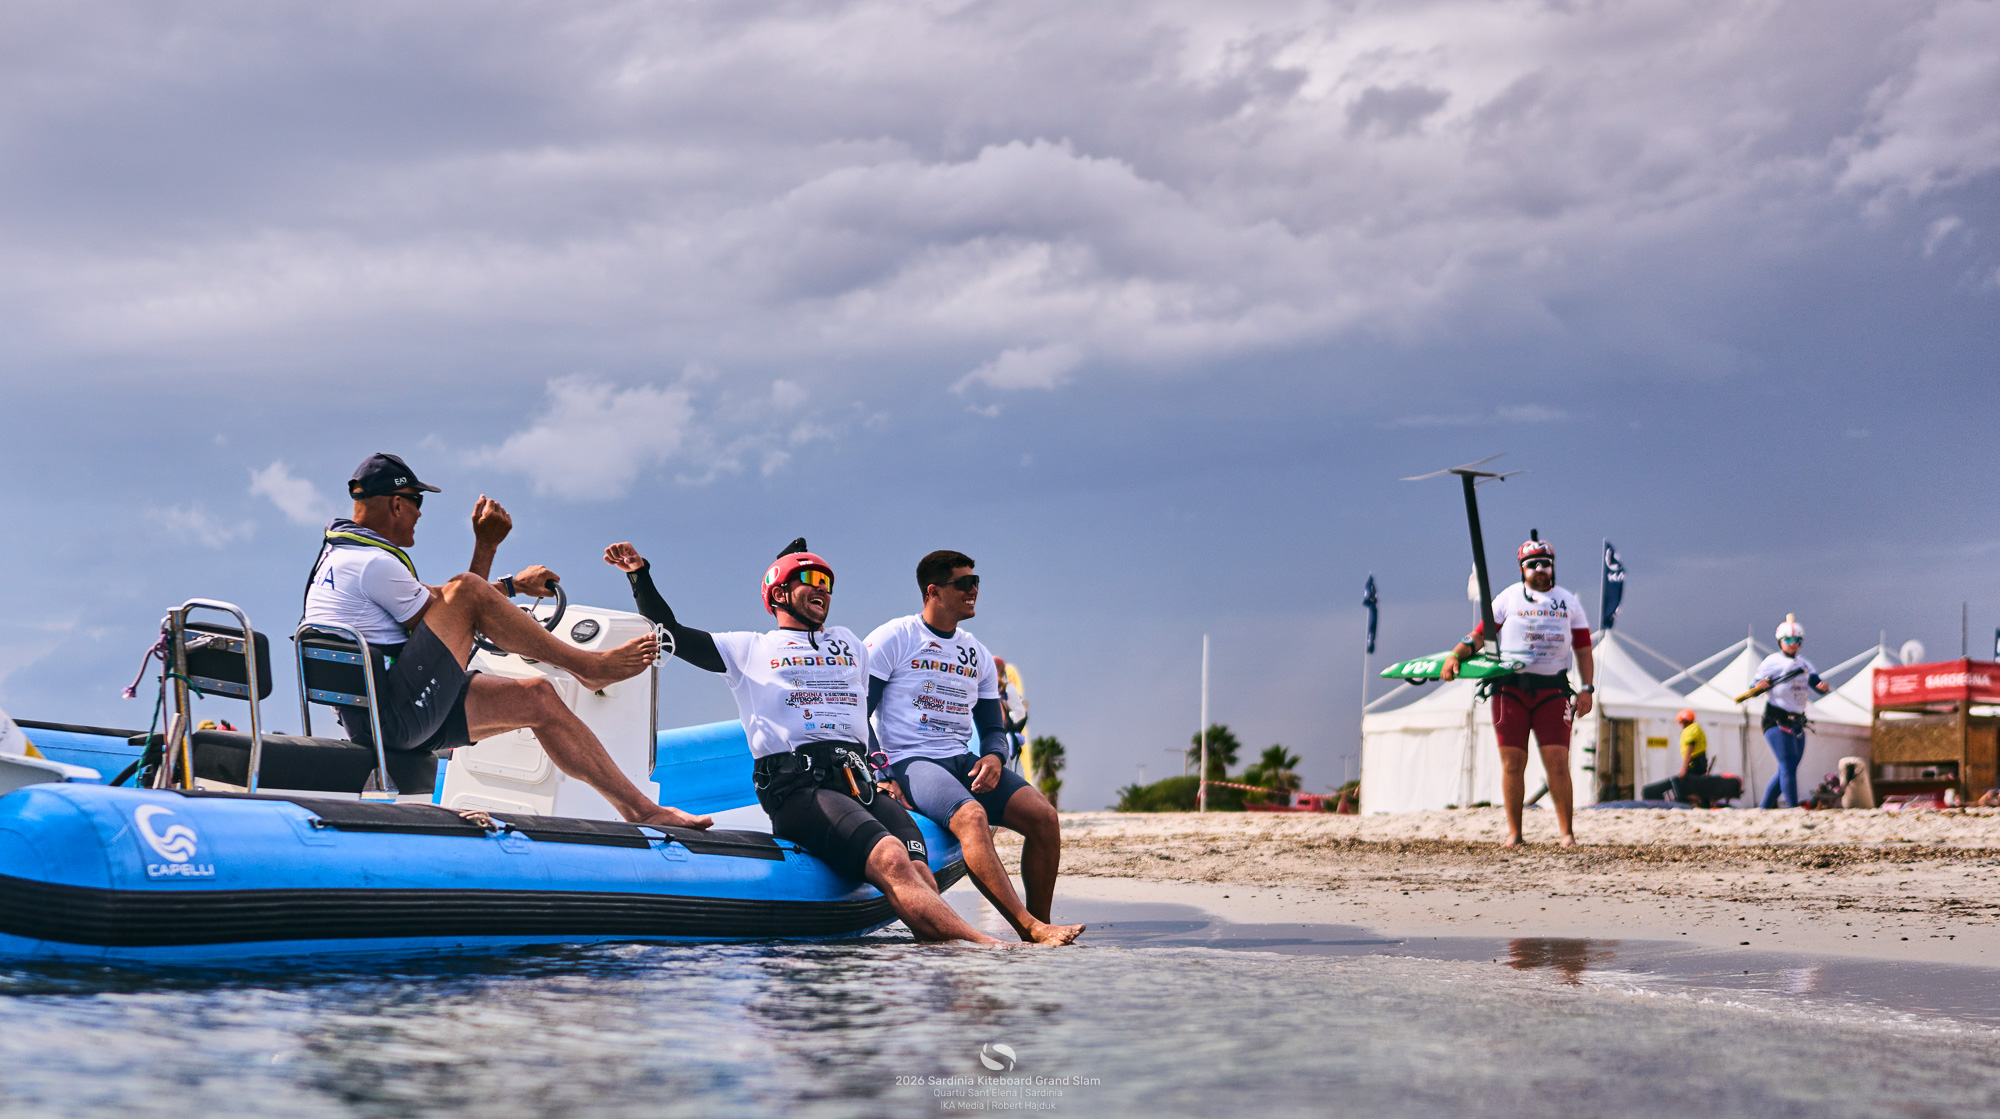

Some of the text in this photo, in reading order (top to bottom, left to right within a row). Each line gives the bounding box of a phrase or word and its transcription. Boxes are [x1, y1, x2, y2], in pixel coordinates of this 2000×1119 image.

[1551, 598, 1567, 611] 34
[1517, 610, 1568, 619] SARDEGNA
[824, 639, 853, 657] 32
[770, 656, 857, 669] SARDEGNA
[956, 645, 978, 667] 38
[911, 659, 977, 679] SARDEGNA
[147, 864, 216, 877] CAPELLI
